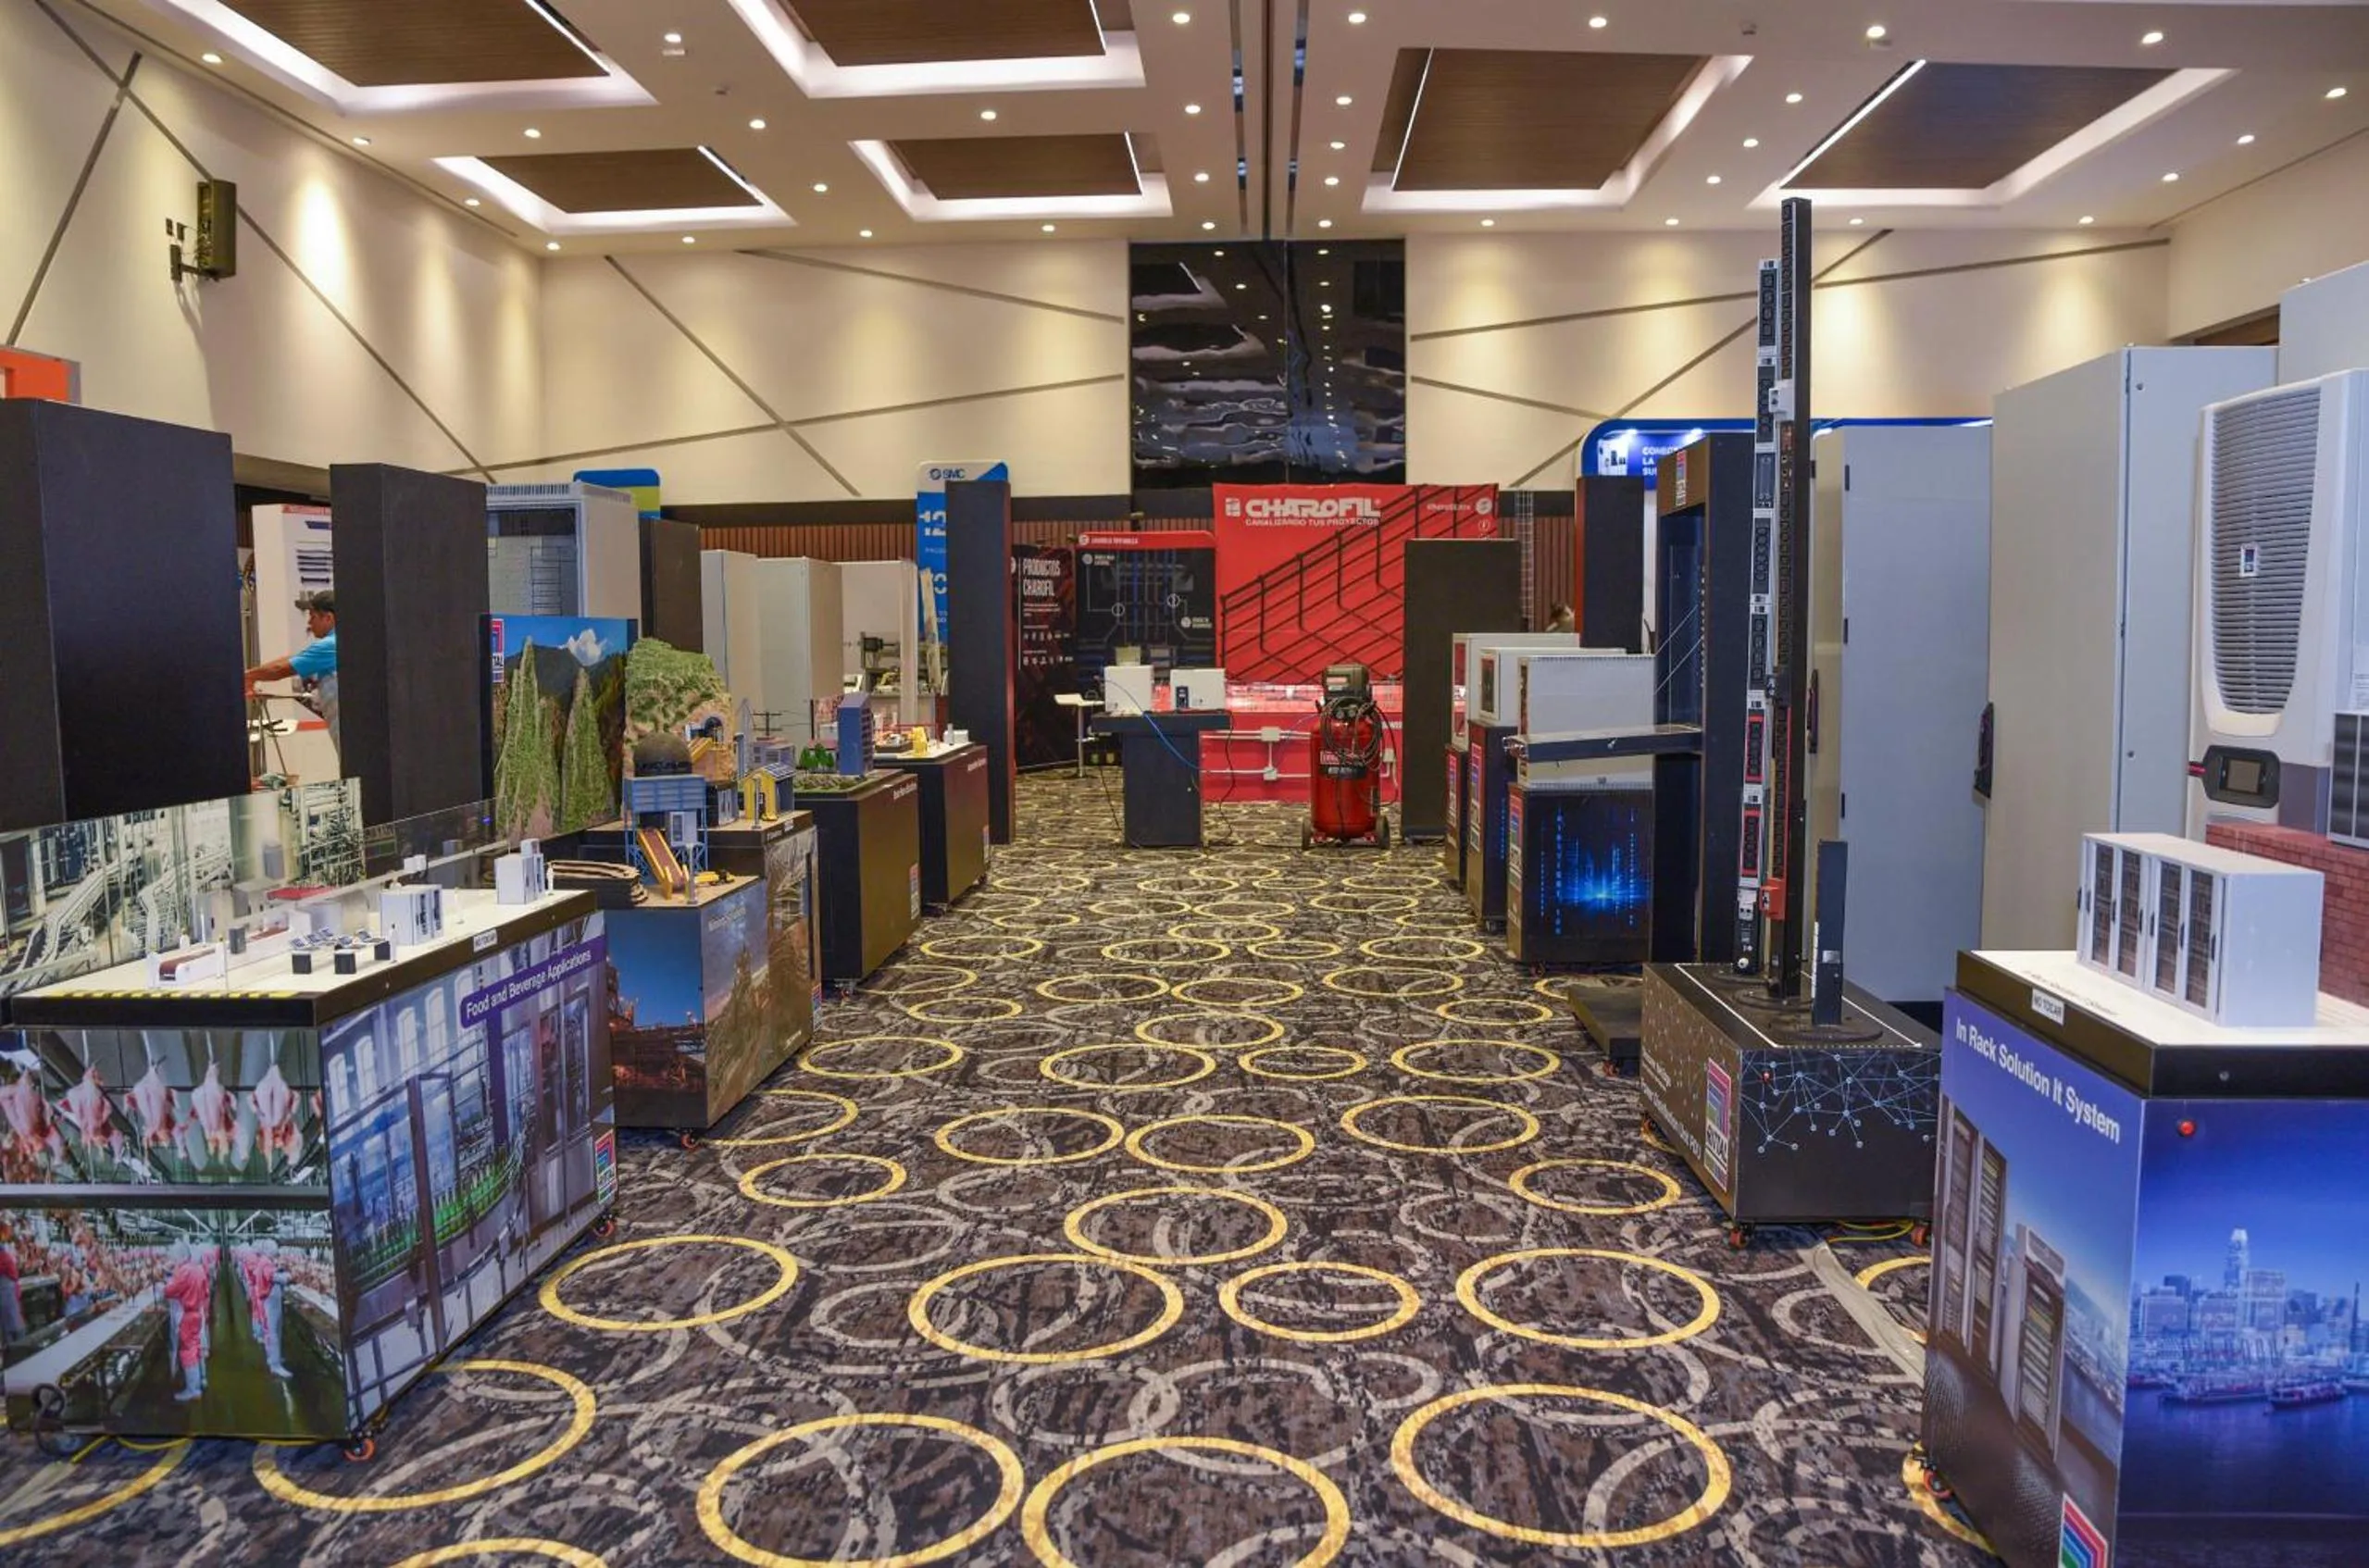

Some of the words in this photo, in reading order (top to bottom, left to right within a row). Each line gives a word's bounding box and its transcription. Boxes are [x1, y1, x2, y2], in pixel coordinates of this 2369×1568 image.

[942, 468, 966, 479] SMC
[1246, 498, 1380, 517] CHAROFIL
[1023, 558, 1061, 576] PRODUCTOS
[1023, 579, 1054, 596] CHAROFIL
[466, 994, 490, 1018] Food
[491, 986, 507, 1007] and
[509, 971, 545, 998] Beverage
[547, 950, 592, 982] Applications
[2034, 994, 2042, 1007] NO
[2043, 999, 2062, 1016] TOCAR
[1956, 1017, 1967, 1042] In
[1969, 1026, 1997, 1063] Rack
[1999, 1044, 2050, 1098] Solution
[2052, 1076, 2063, 1106] It
[2065, 1087, 2120, 1144] System
